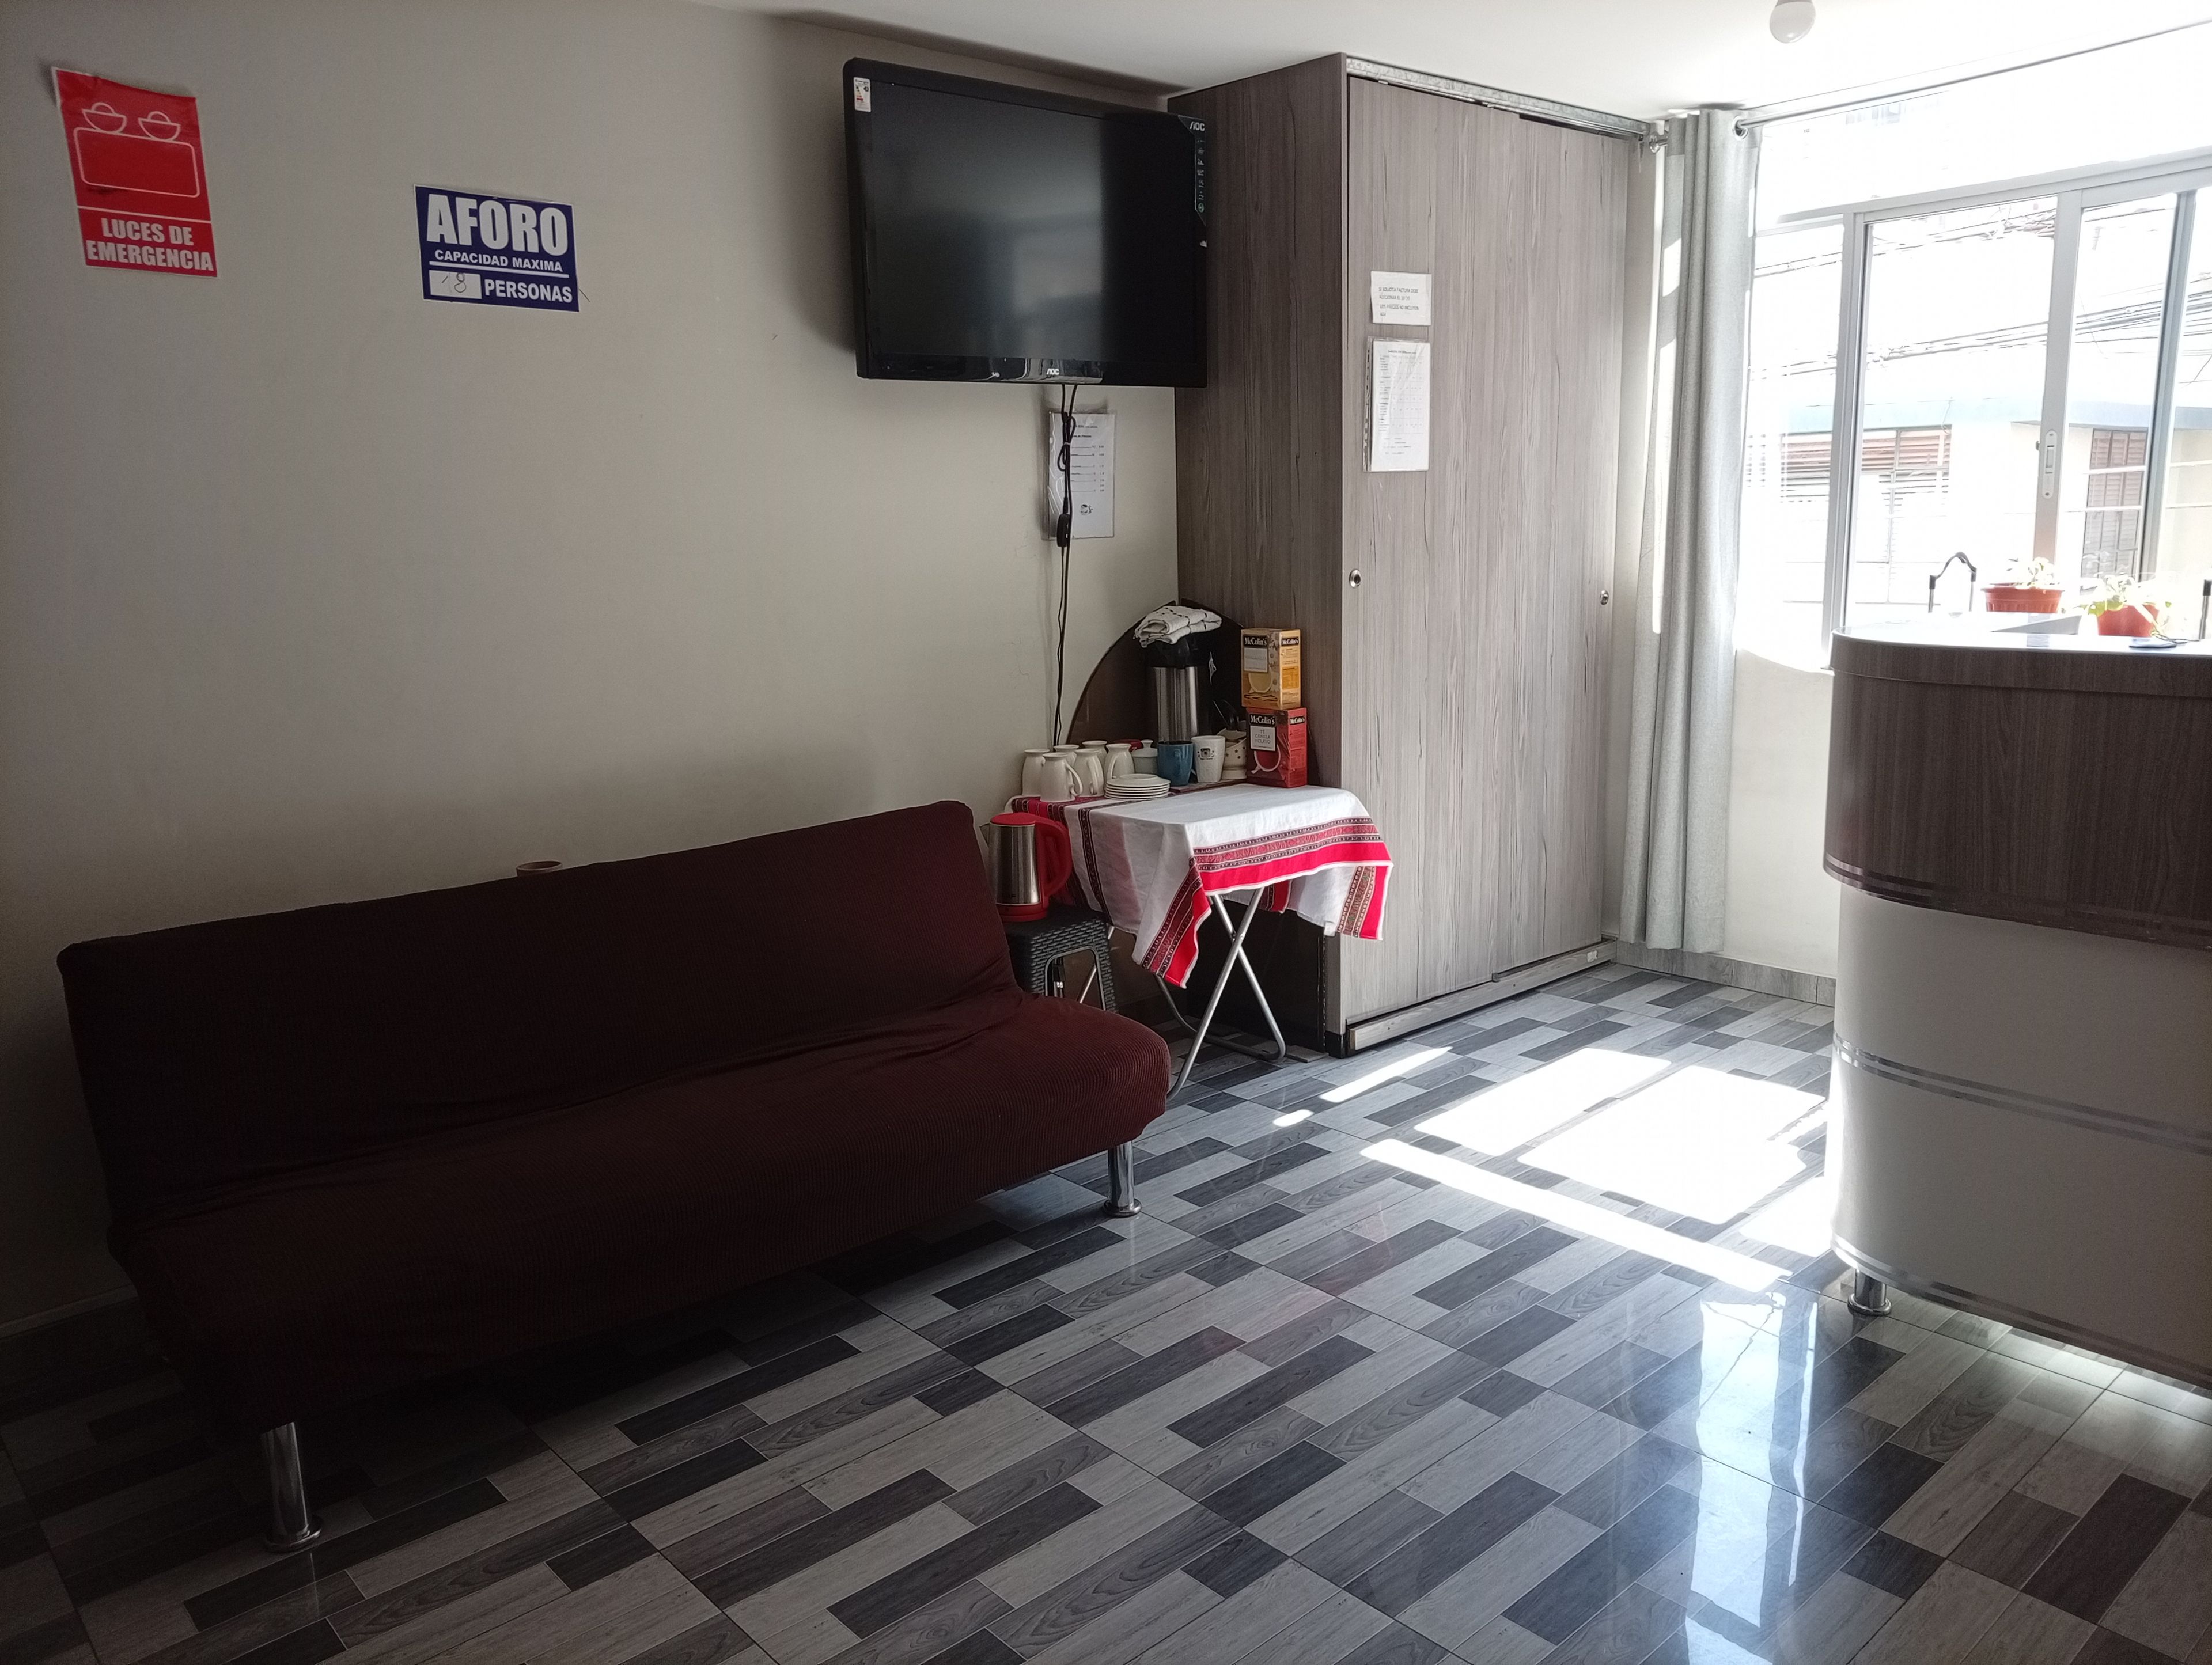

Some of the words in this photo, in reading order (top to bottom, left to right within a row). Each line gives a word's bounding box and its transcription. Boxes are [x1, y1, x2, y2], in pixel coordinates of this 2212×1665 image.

[1190, 121, 1205, 131] AOC
[101, 217, 165, 243] LUCES
[168, 225, 194, 246] DE
[426, 193, 569, 256] AFORO
[85, 240, 214, 271] EMERGENCIA
[435, 249, 508, 267] CAPACIDAD
[512, 257, 563, 272] MAXIMA
[484, 278, 573, 303] PERSONAS
[1244, 636, 1267, 646] McColin's
[1251, 715, 1275, 725] McColin's
